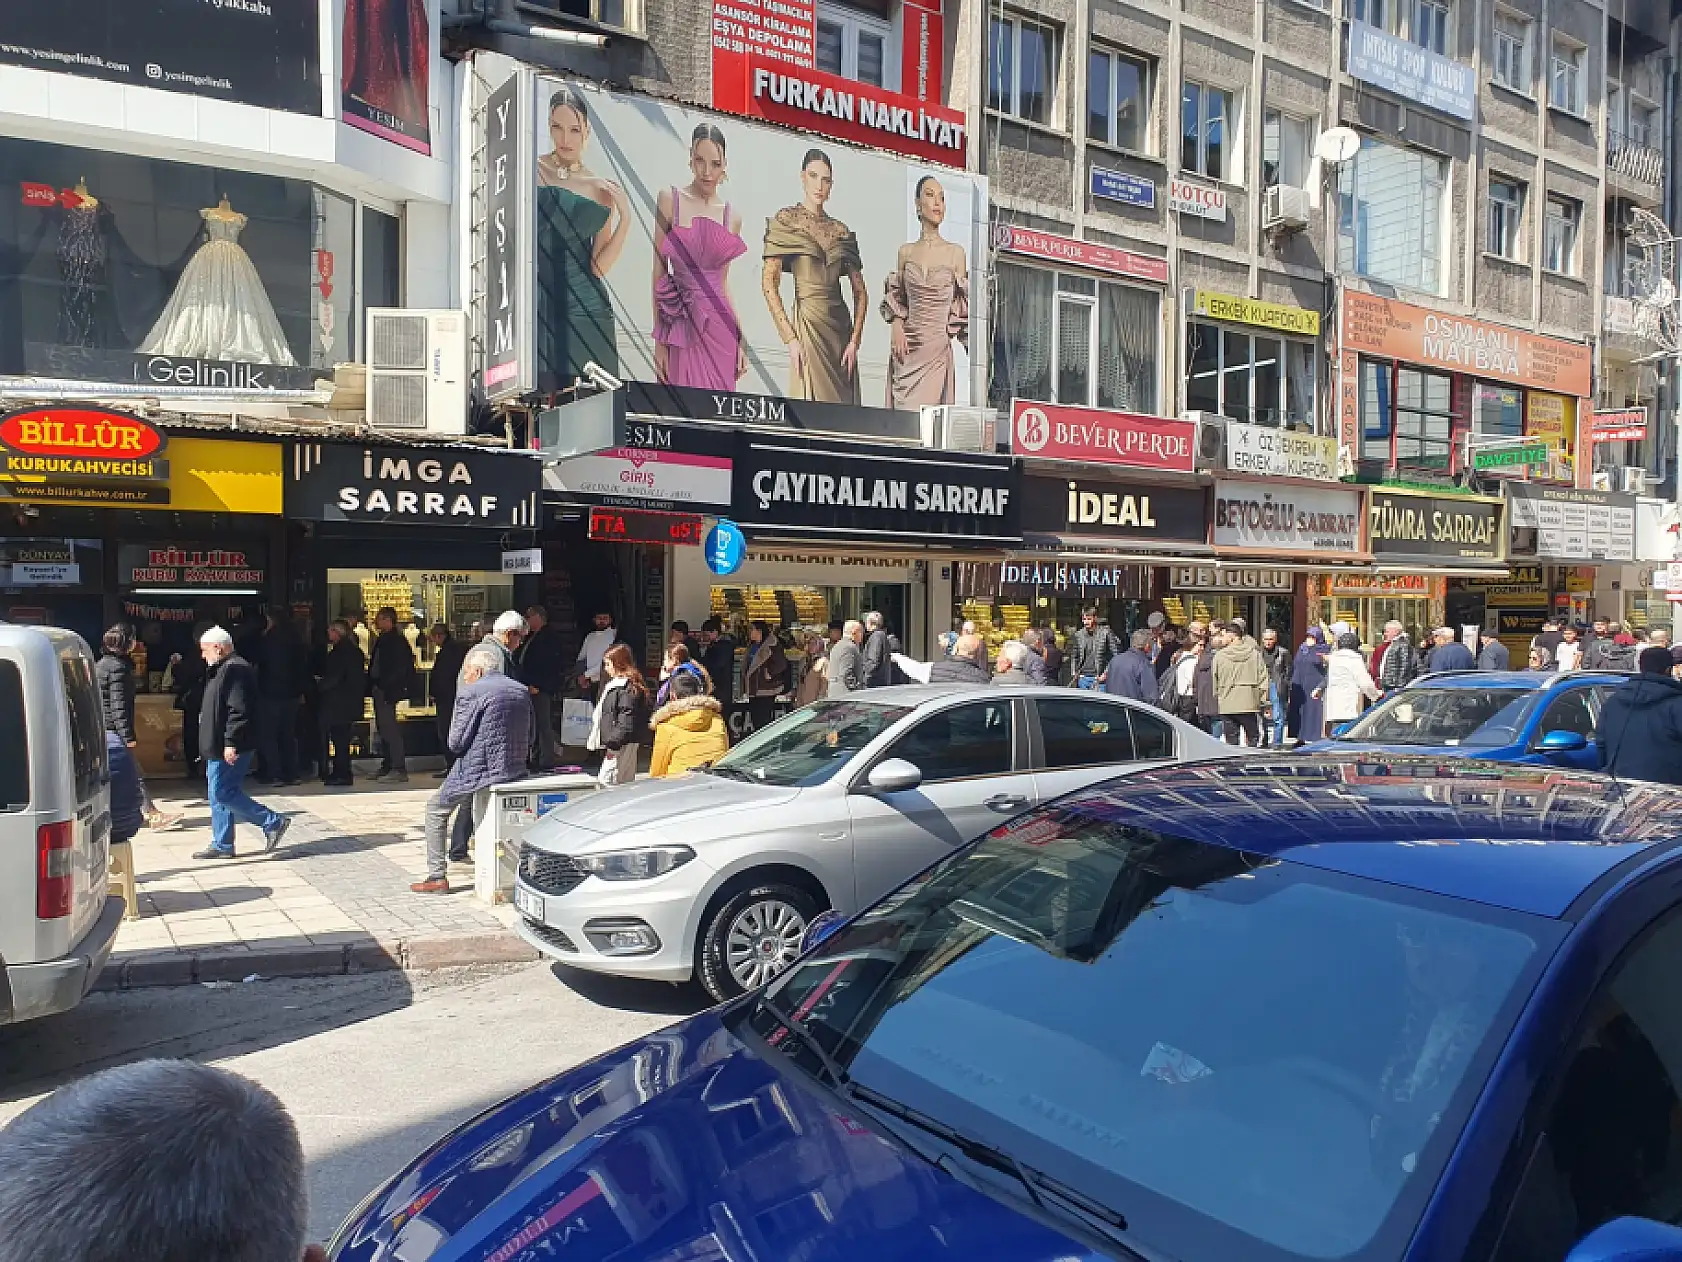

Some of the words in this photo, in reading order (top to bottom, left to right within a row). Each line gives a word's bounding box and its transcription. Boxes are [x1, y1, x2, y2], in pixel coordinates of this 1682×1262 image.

[748, 27, 812, 56] DEPOLAMA
[754, 67, 854, 121] FURKAN
[860, 97, 964, 150] NAKLİYAT
[1423, 336, 1520, 377] MATBAA
[1126, 430, 1190, 460] PERDE
[8, 456, 153, 477] KURUKAHVECİSİ
[363, 450, 473, 485] İMGA
[337, 486, 498, 518] SARRAF
[752, 470, 908, 509] ÇAYIRALAN
[914, 483, 1009, 516] SARRAF
[1068, 481, 1156, 527] İDEAL
[1371, 499, 1427, 540] ZÜMRA
[1431, 510, 1495, 546] SARRAF
